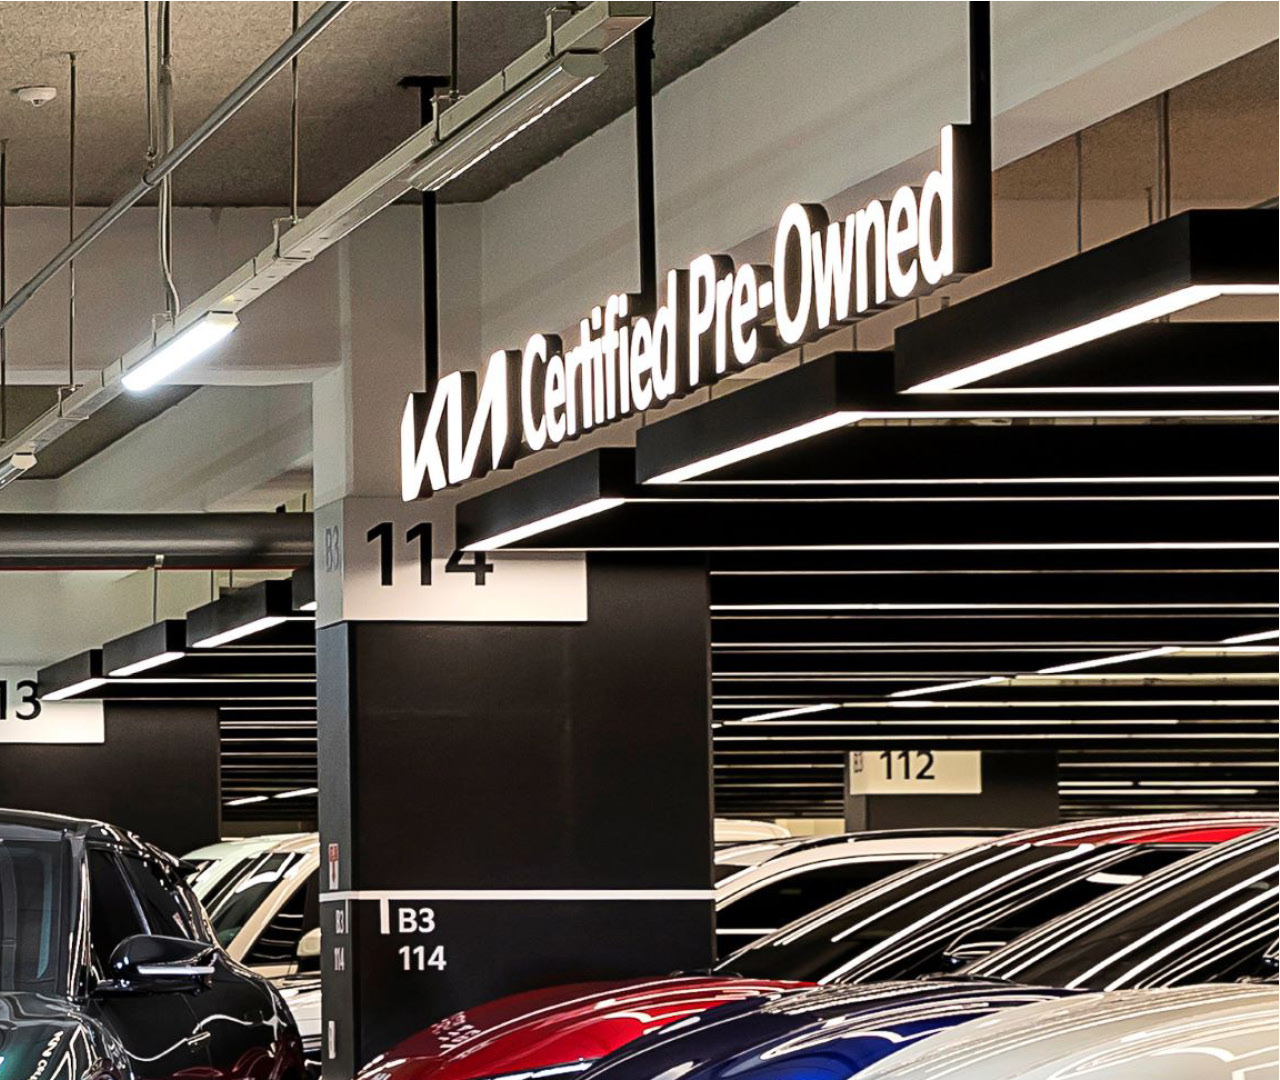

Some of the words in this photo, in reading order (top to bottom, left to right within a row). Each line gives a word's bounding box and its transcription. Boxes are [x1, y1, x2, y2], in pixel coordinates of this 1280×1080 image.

[521, 268, 677, 452] Certified
[689, 124, 955, 387] Pre-Owned
[879, 750, 936, 780] 112
[397, 908, 436, 934] B3
[397, 945, 448, 971] 114
